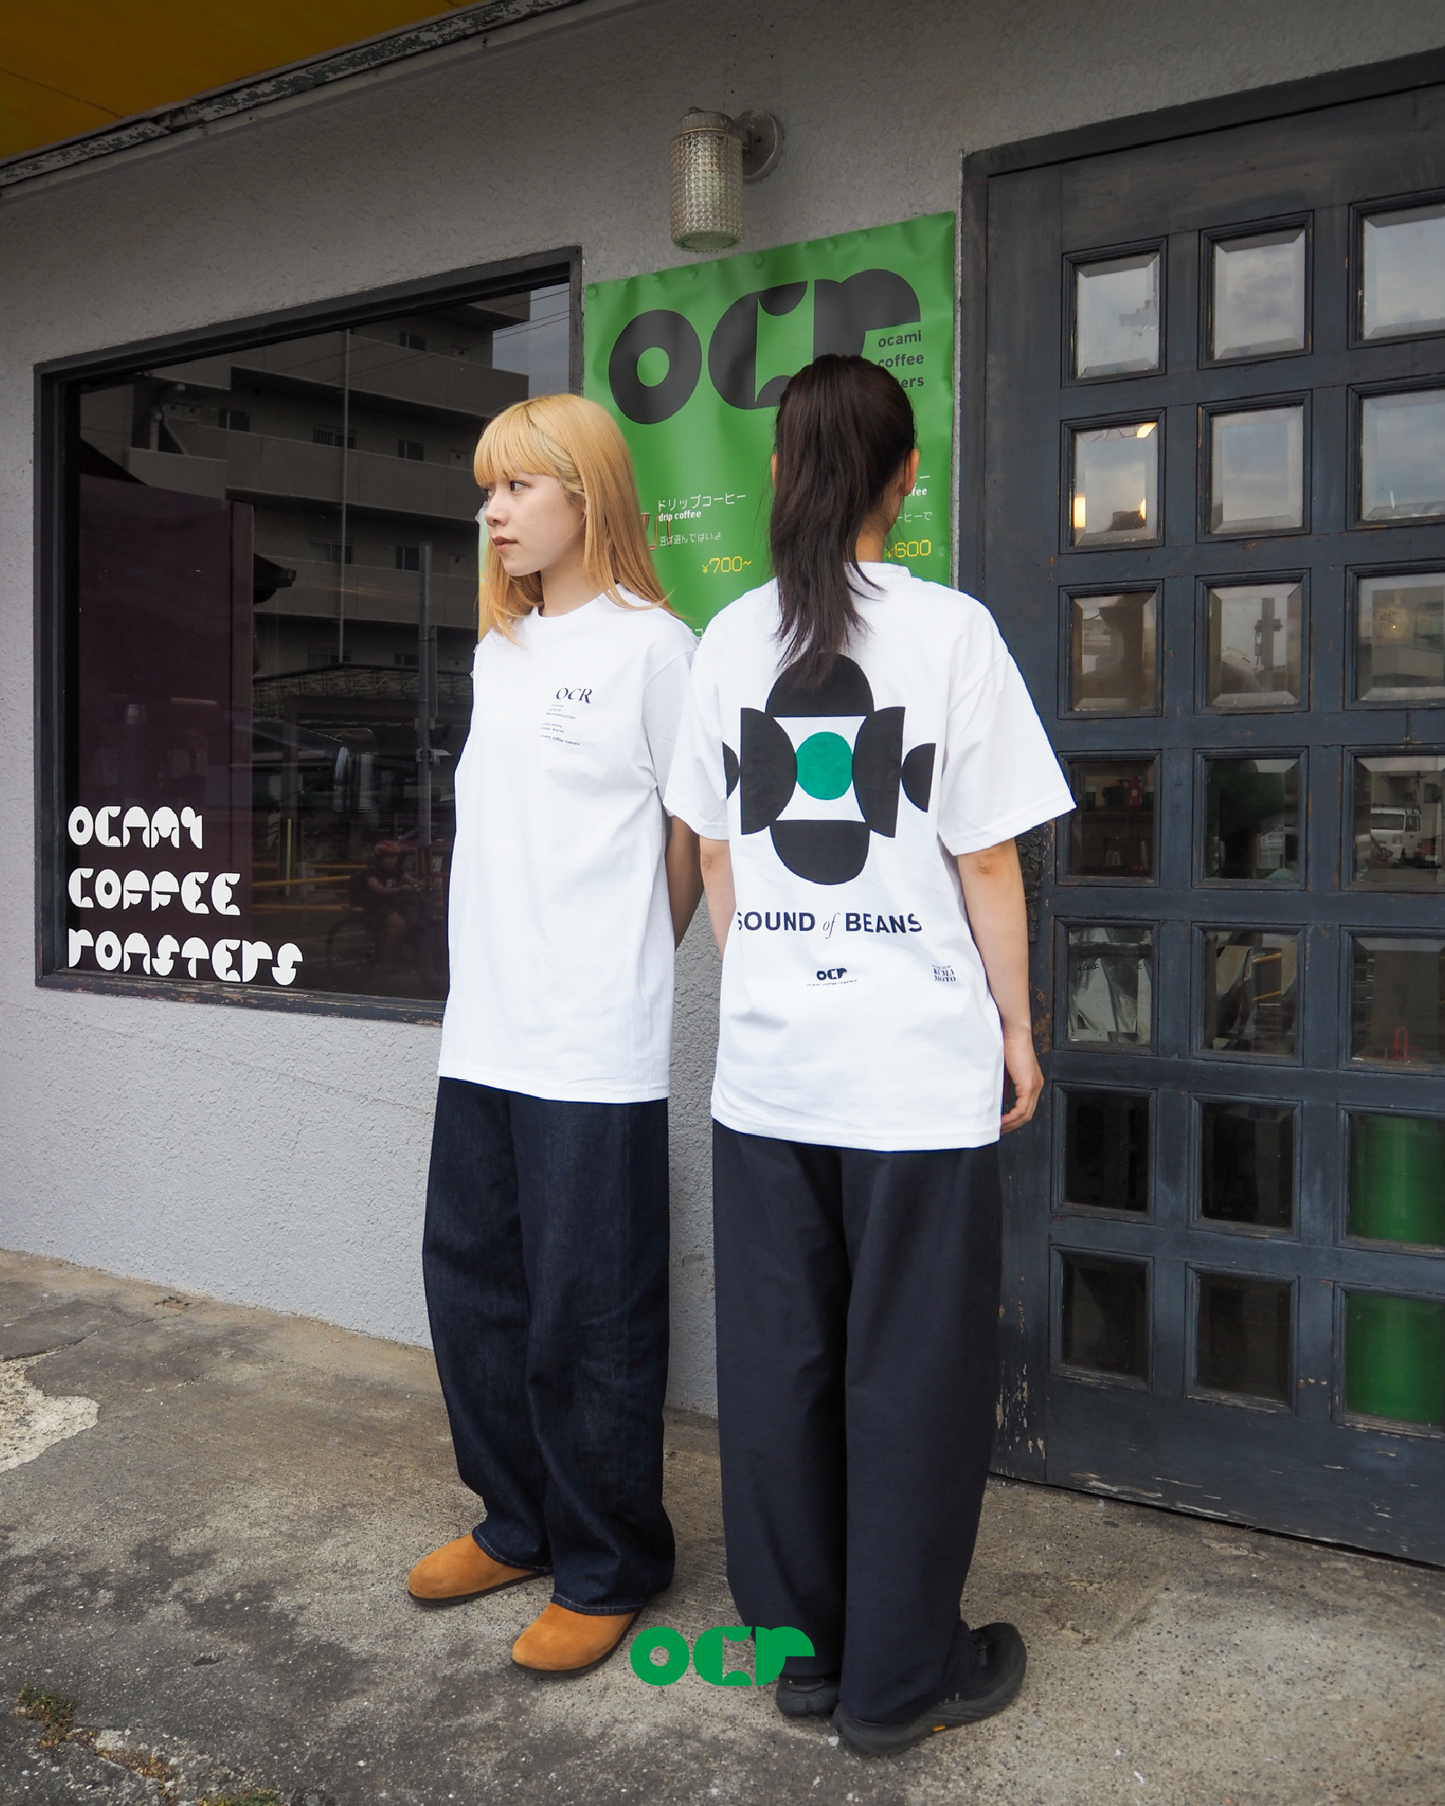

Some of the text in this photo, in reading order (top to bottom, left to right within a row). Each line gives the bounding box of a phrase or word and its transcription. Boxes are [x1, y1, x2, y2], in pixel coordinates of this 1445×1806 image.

[878, 330, 922, 348] ocami
[878, 354, 924, 368] coffee
[658, 493, 746, 512] ドリップコーヒー
[658, 510, 702, 522] drip coffee
[556, 687, 592, 704] OCR
[822, 911, 841, 940] of
[845, 912, 923, 933] BEANS
